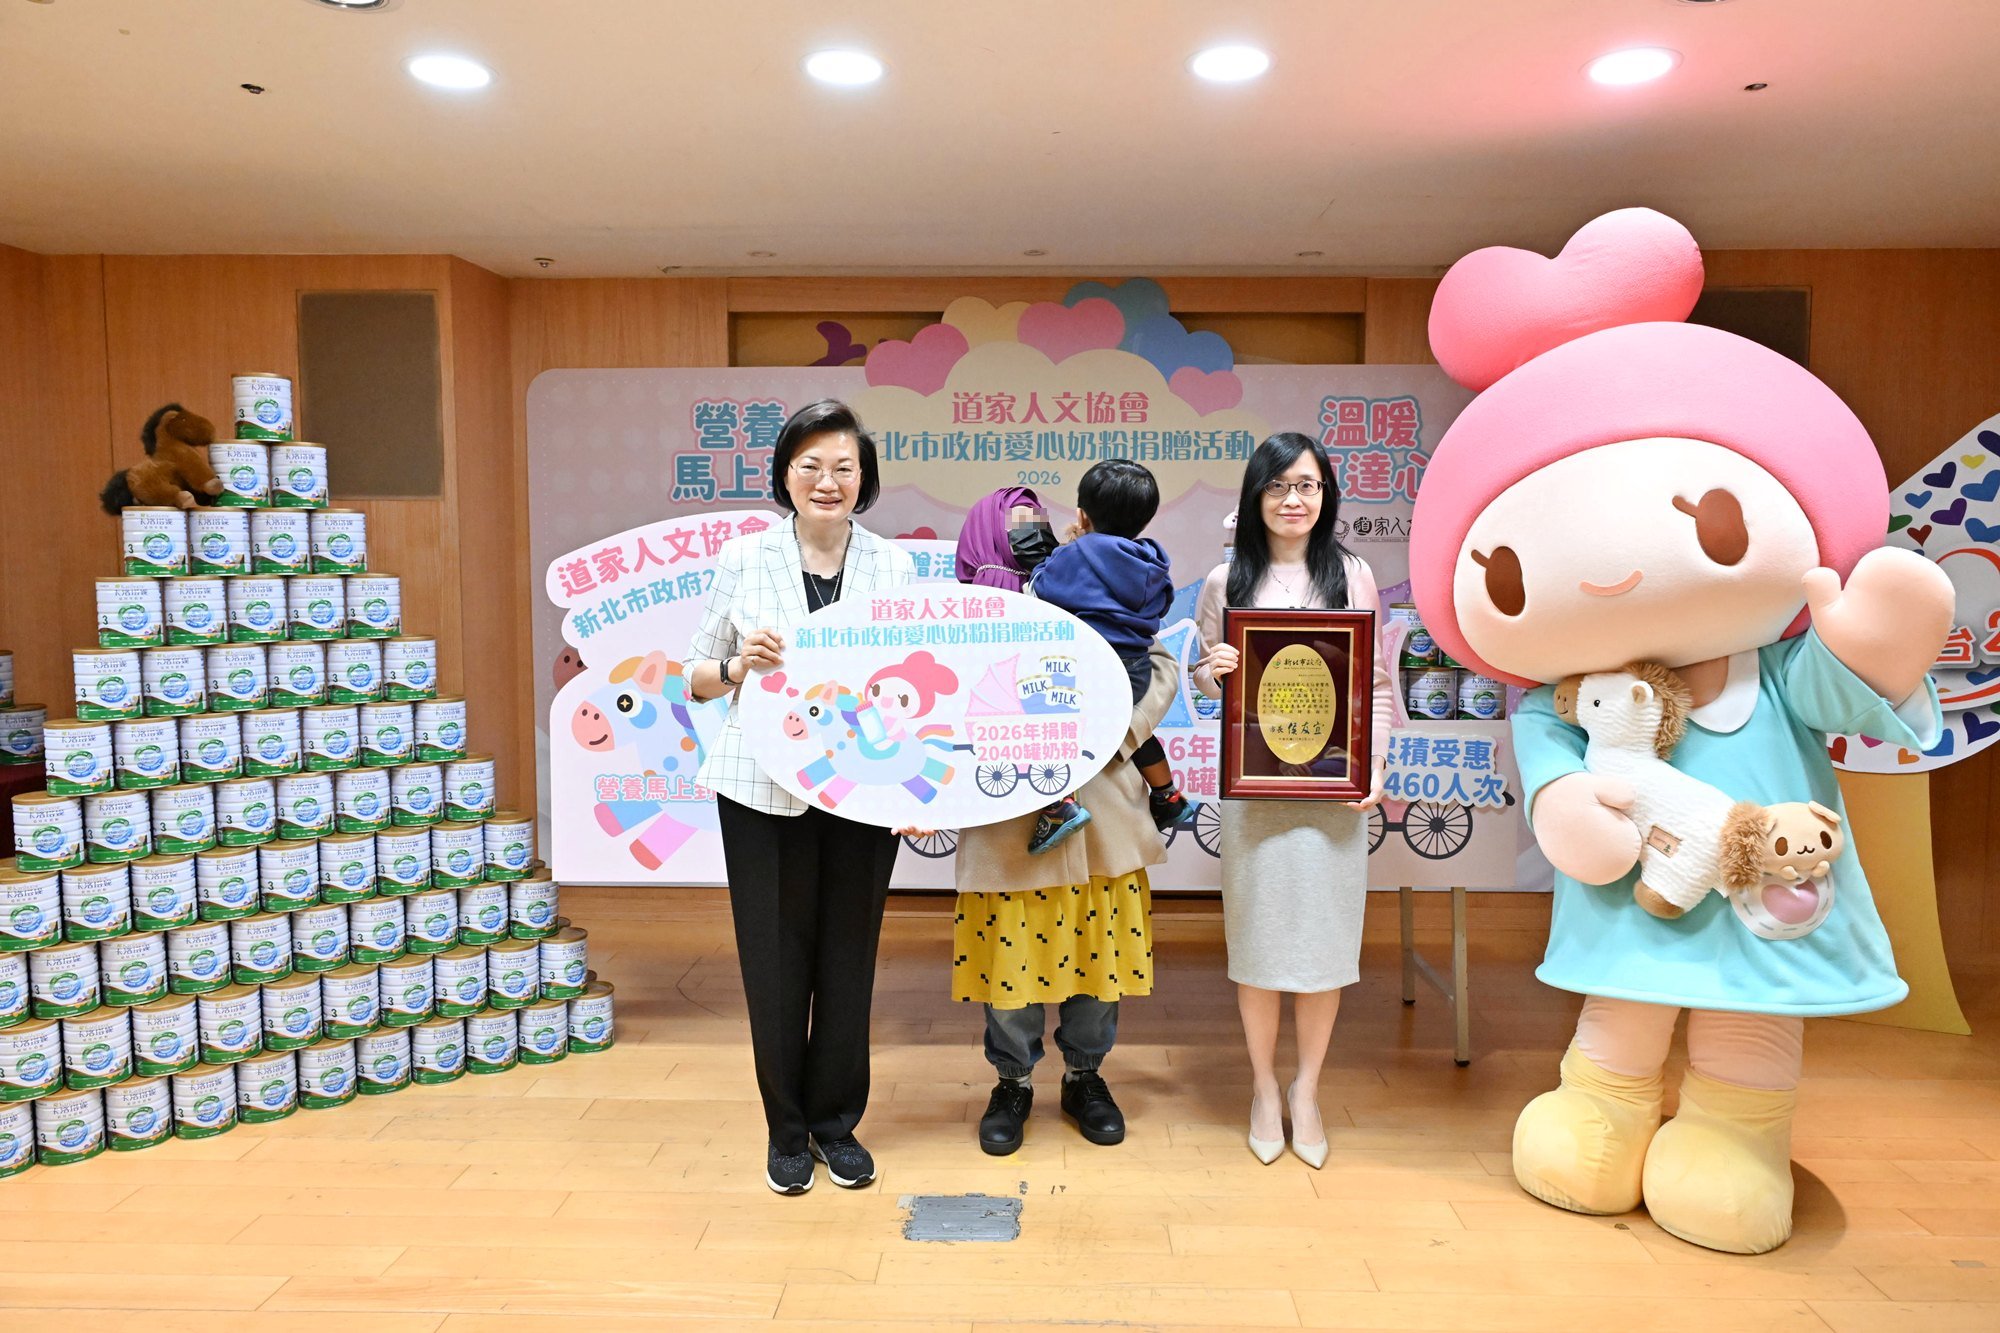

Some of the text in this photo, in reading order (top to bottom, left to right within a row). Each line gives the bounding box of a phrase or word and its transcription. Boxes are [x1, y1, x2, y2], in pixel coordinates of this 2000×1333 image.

[952, 392, 1149, 424] 道家人文協會
[239, 409, 245, 418] 3
[695, 402, 785, 449] 營養
[1323, 400, 1418, 448] 溫暖
[871, 430, 1255, 462] 北市政府愛心奶粉捐贈活動
[275, 478, 280, 486] 3
[672, 454, 774, 501] 馬上
[1017, 470, 1061, 485] 2026
[128, 544, 134, 553] 3
[255, 544, 260, 552] 3
[314, 544, 319, 552] 3
[351, 608, 356, 617] 3
[871, 596, 1006, 621] 道家人文協會
[168, 613, 173, 622] 3
[232, 611, 237, 620] 3
[294, 610, 299, 618] 3
[103, 615, 108, 625] 3
[795, 620, 1075, 648] 新北市政府愛心奶粉捐贈活動
[1046, 661, 1071, 673] MILK
[333, 674, 338, 682] 3
[390, 671, 396, 680] 3
[213, 680, 218, 689] 3
[274, 677, 280, 685] 3
[146, 684, 151, 693] 3
[1022, 680, 1048, 695] MILK
[81, 688, 86, 697] 3
[1051, 691, 1076, 705] MILK
[1412, 700, 1418, 708] 3
[1459, 700, 1465, 708] 3
[423, 732, 428, 740] 3
[976, 721, 1078, 742] 2026年捐贈
[363, 735, 368, 744] 3
[308, 741, 314, 749] 3
[1158, 734, 1217, 764] 6年
[184, 750, 189, 759] 3
[977, 741, 1079, 762] 2040罐奶粉
[119, 756, 124, 766] 3
[50, 763, 55, 772] 3
[447, 791, 452, 800] 3
[394, 796, 399, 805] 3
[340, 803, 345, 811] 3
[280, 808, 285, 816] 3
[226, 815, 232, 824] 3
[160, 823, 166, 831] 3
[18, 838, 23, 847] 3
[490, 853, 495, 861] 3
[434, 858, 439, 867] 3
[381, 865, 385, 874] 3
[326, 873, 330, 881] 3
[268, 882, 274, 890] 3
[204, 889, 209, 898] 3
[66, 908, 71, 917] 3
[514, 910, 519, 919] 3
[465, 916, 470, 924] 3
[411, 924, 416, 932] 3
[358, 934, 363, 942] 3
[297, 942, 302, 950] 3
[236, 952, 241, 961] 3
[173, 962, 179, 971] 3
[105, 973, 110, 983] 3
[550, 972, 555, 980] 3
[34, 985, 40, 994] 3
[442, 988, 447, 996] 3
[388, 997, 394, 1005] 3
[332, 1009, 337, 1017] 3
[268, 1020, 274, 1028] 3
[569, 1026, 574, 1034] 3
[204, 1032, 209, 1041] 3
[521, 1036, 526, 1044] 3
[136, 1043, 141, 1053] 3
[469, 1046, 474, 1054] 3
[68, 1056, 73, 1065] 3
[420, 1056, 426, 1065] 3
[360, 1065, 365, 1074] 3
[305, 1080, 310, 1088] 3
[244, 1094, 250, 1102] 3
[179, 1109, 184, 1118] 3
[111, 1120, 116, 1128] 3
[41, 1134, 46, 1143] 3
